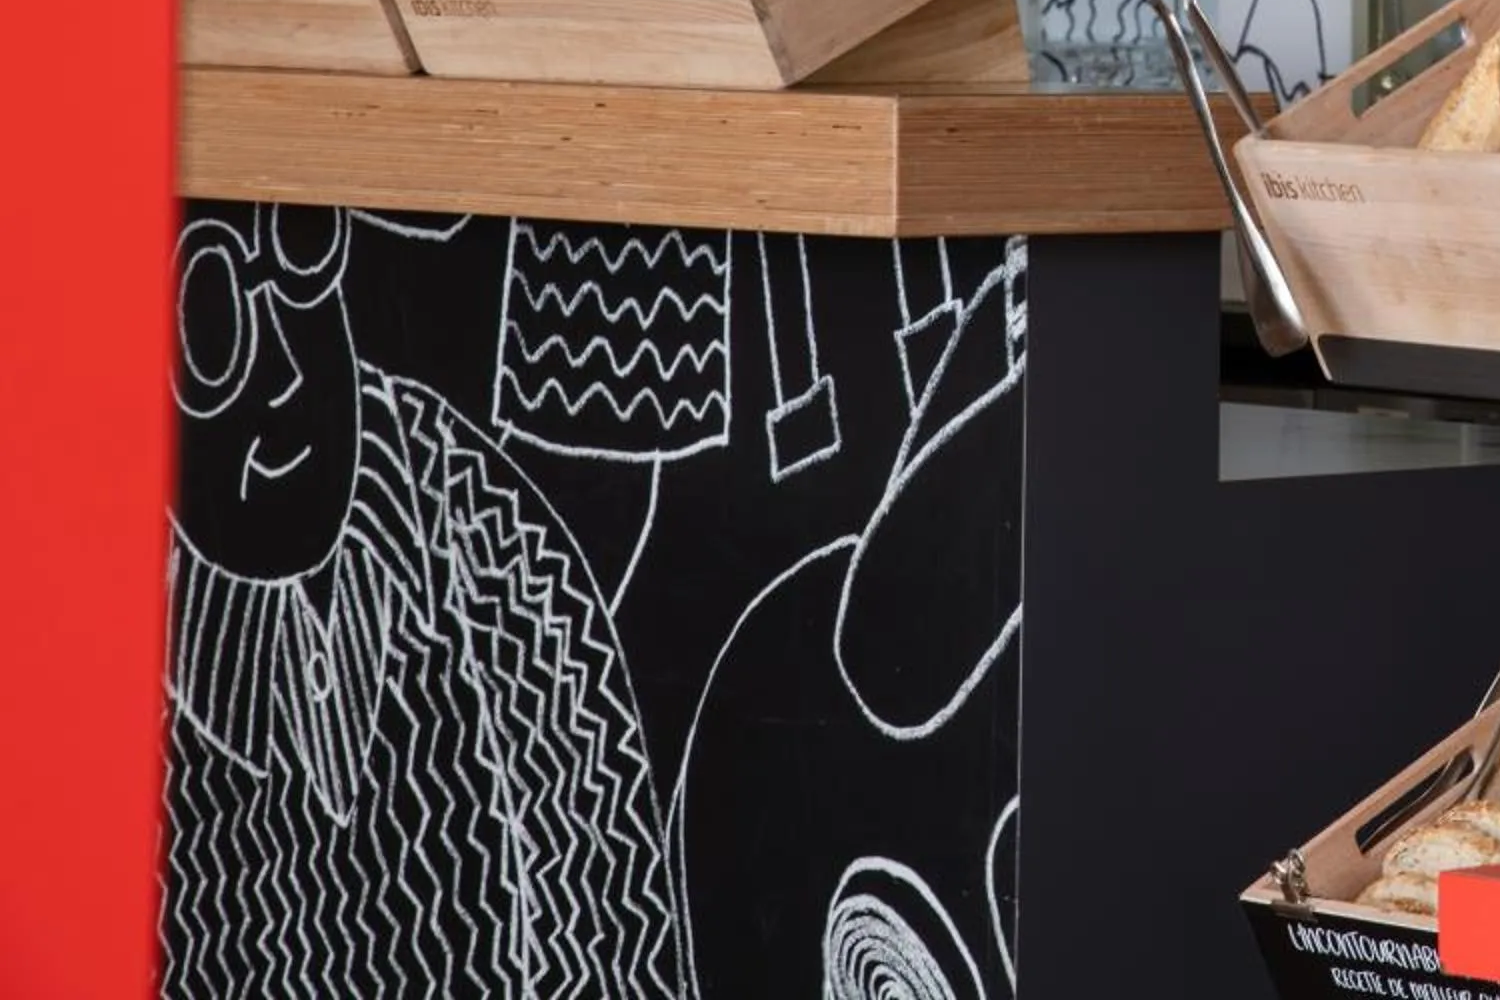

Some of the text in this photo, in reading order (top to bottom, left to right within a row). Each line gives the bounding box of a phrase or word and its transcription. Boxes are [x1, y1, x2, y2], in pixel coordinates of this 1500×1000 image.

[1260, 171, 1366, 203] ibis kitchen
[1330, 967, 1387, 995] RECETTE
[1388, 977, 1409, 999] DE
